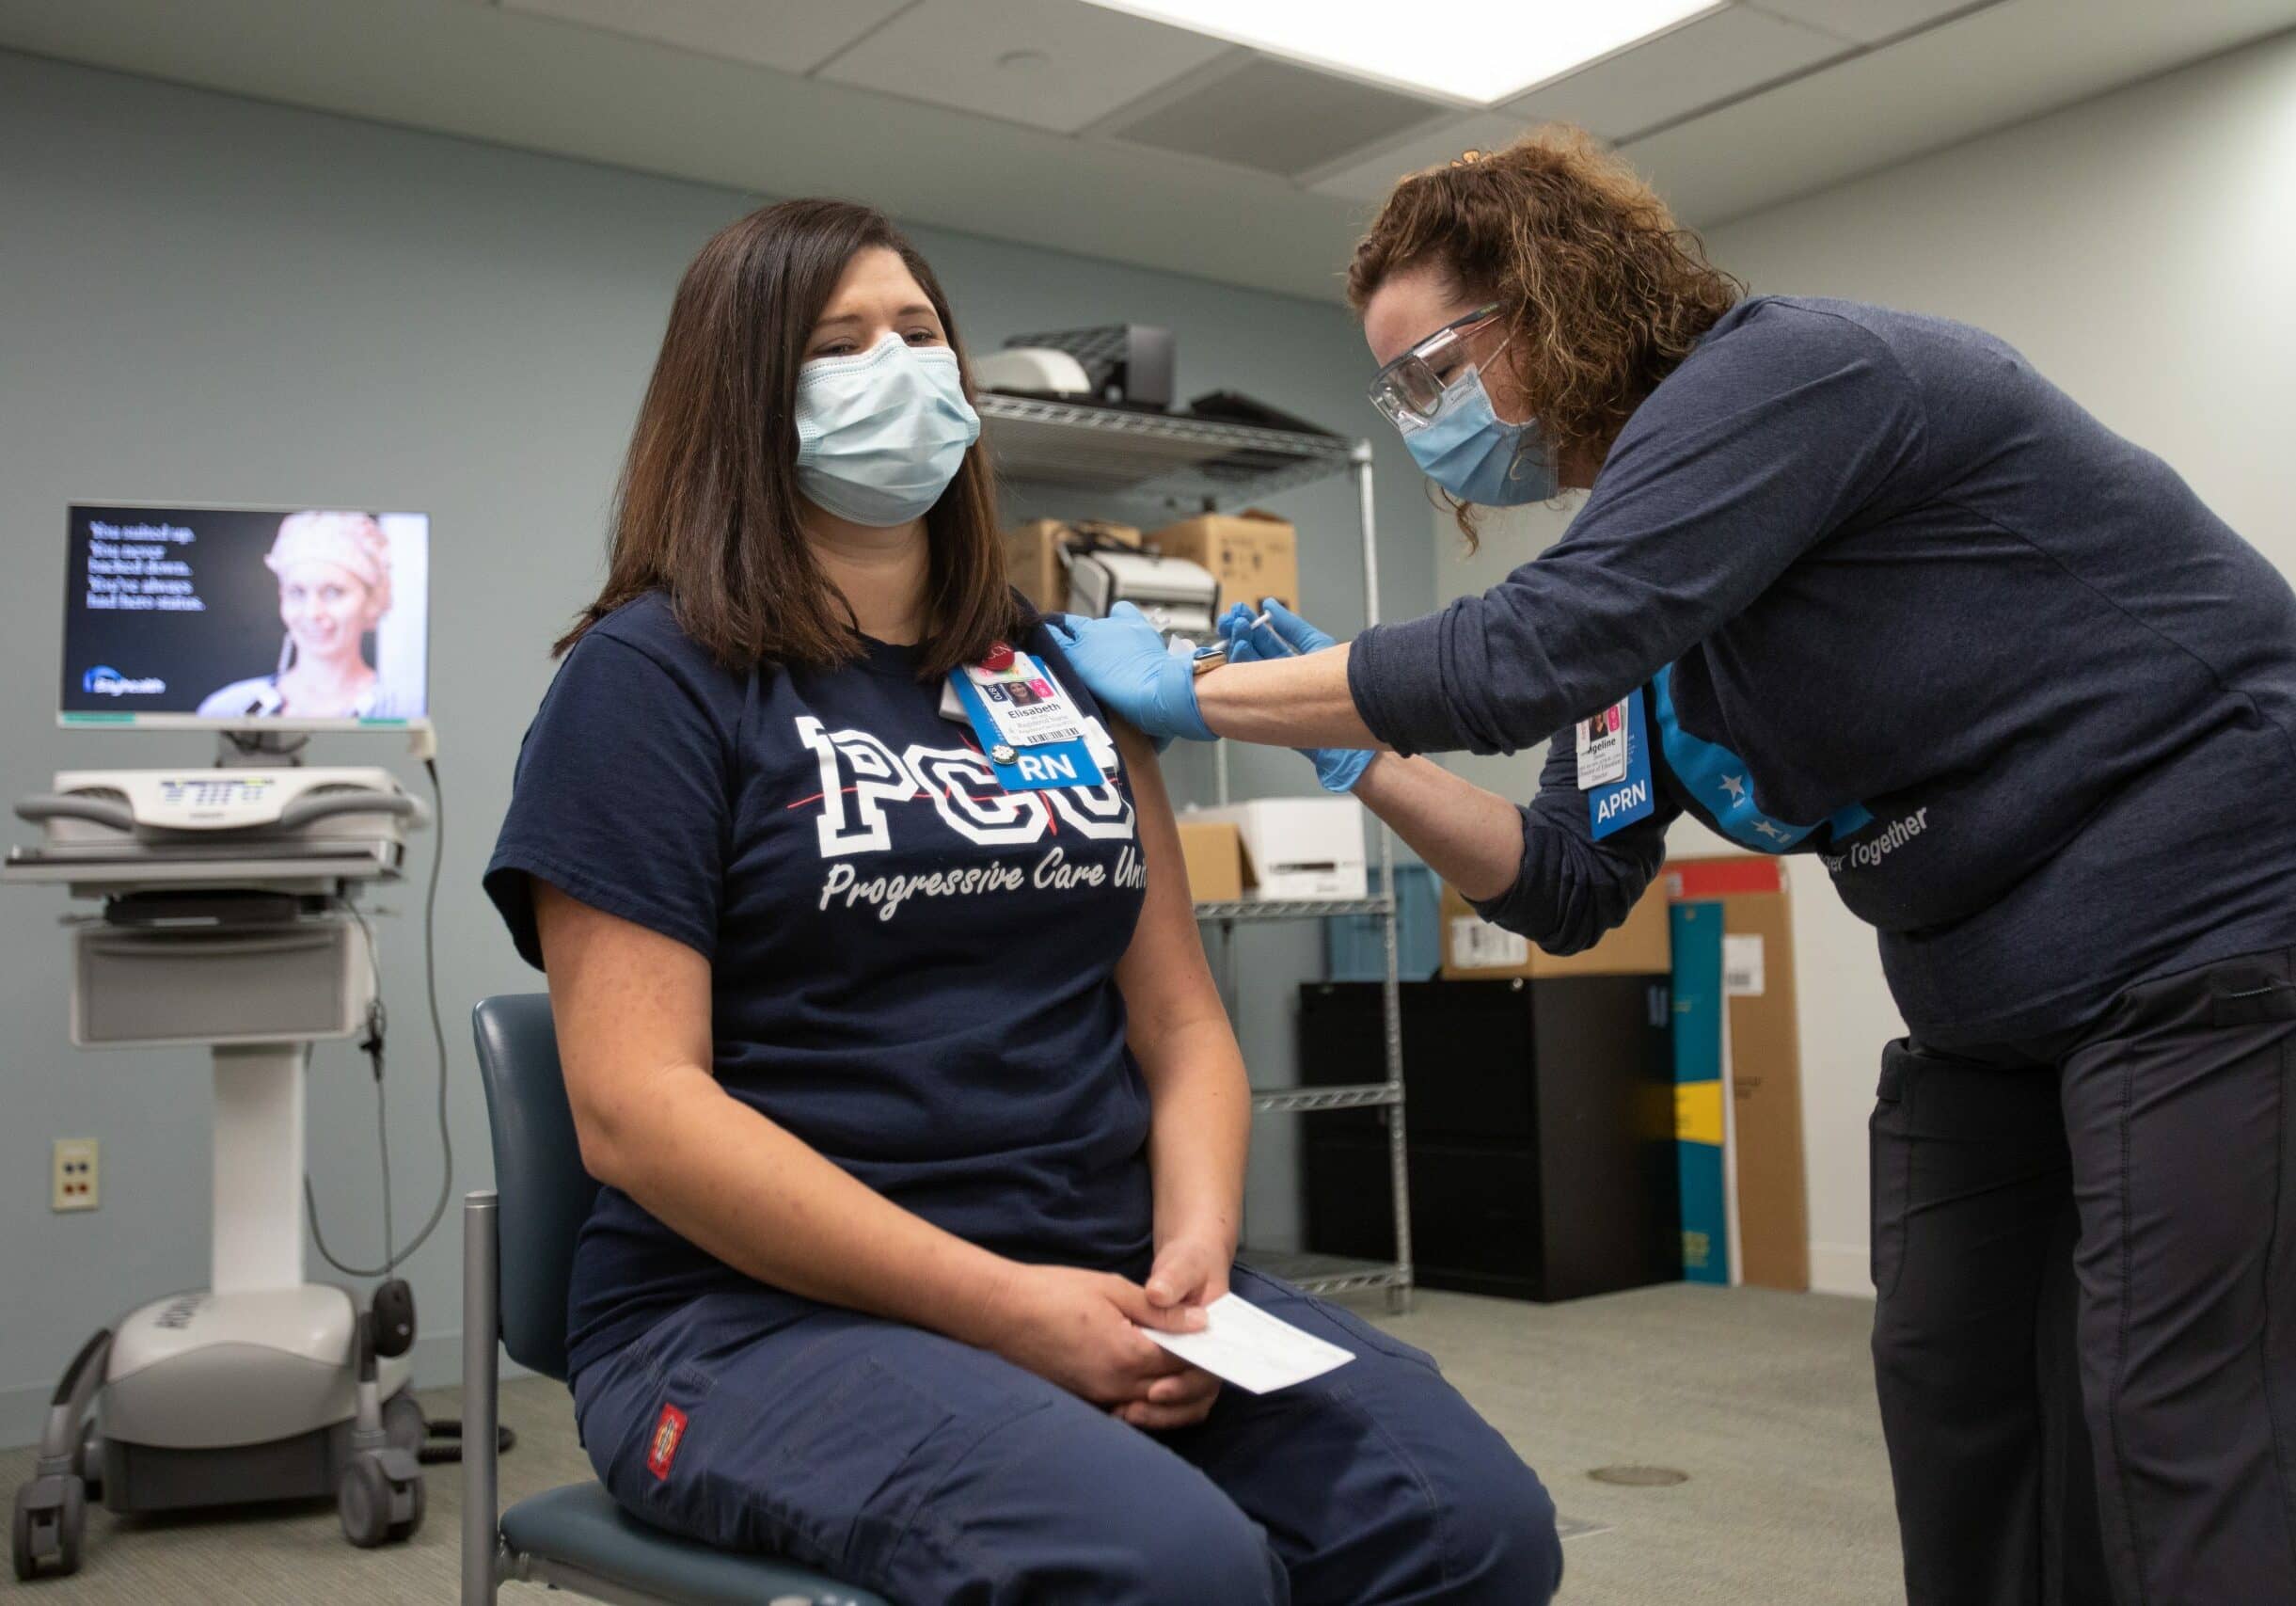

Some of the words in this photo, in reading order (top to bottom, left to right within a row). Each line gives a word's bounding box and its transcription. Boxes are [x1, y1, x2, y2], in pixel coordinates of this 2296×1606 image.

[1007, 703, 1061, 719] Elisabeth
[1019, 754, 1078, 781] RN
[1597, 779, 1646, 824] APRN
[1851, 806, 1927, 867] Together
[819, 862, 1024, 921] Progressive
[1035, 846, 1106, 889] Care
